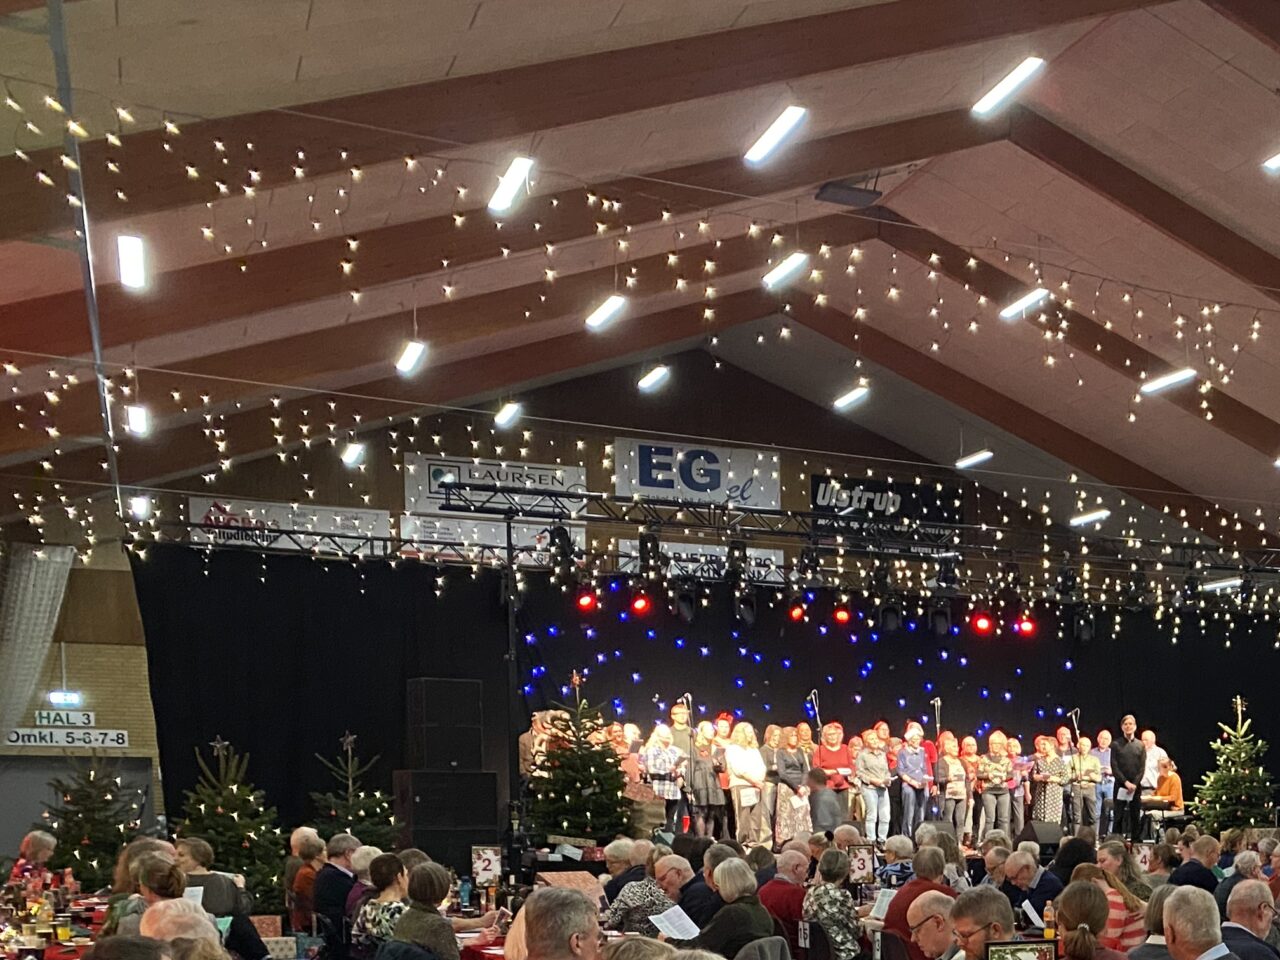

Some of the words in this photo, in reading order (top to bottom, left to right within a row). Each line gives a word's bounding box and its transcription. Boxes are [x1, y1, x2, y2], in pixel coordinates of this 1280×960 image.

[638, 445, 721, 492] EG
[468, 468, 564, 486] LAURSEN
[816, 483, 902, 516] Ulstrup
[38, 711, 76, 725] HAL
[81, 713, 91, 725] 3
[65, 732, 125, 745] 5-6-7-8
[481, 858, 492, 871] 2
[857, 858, 866, 871] 3
